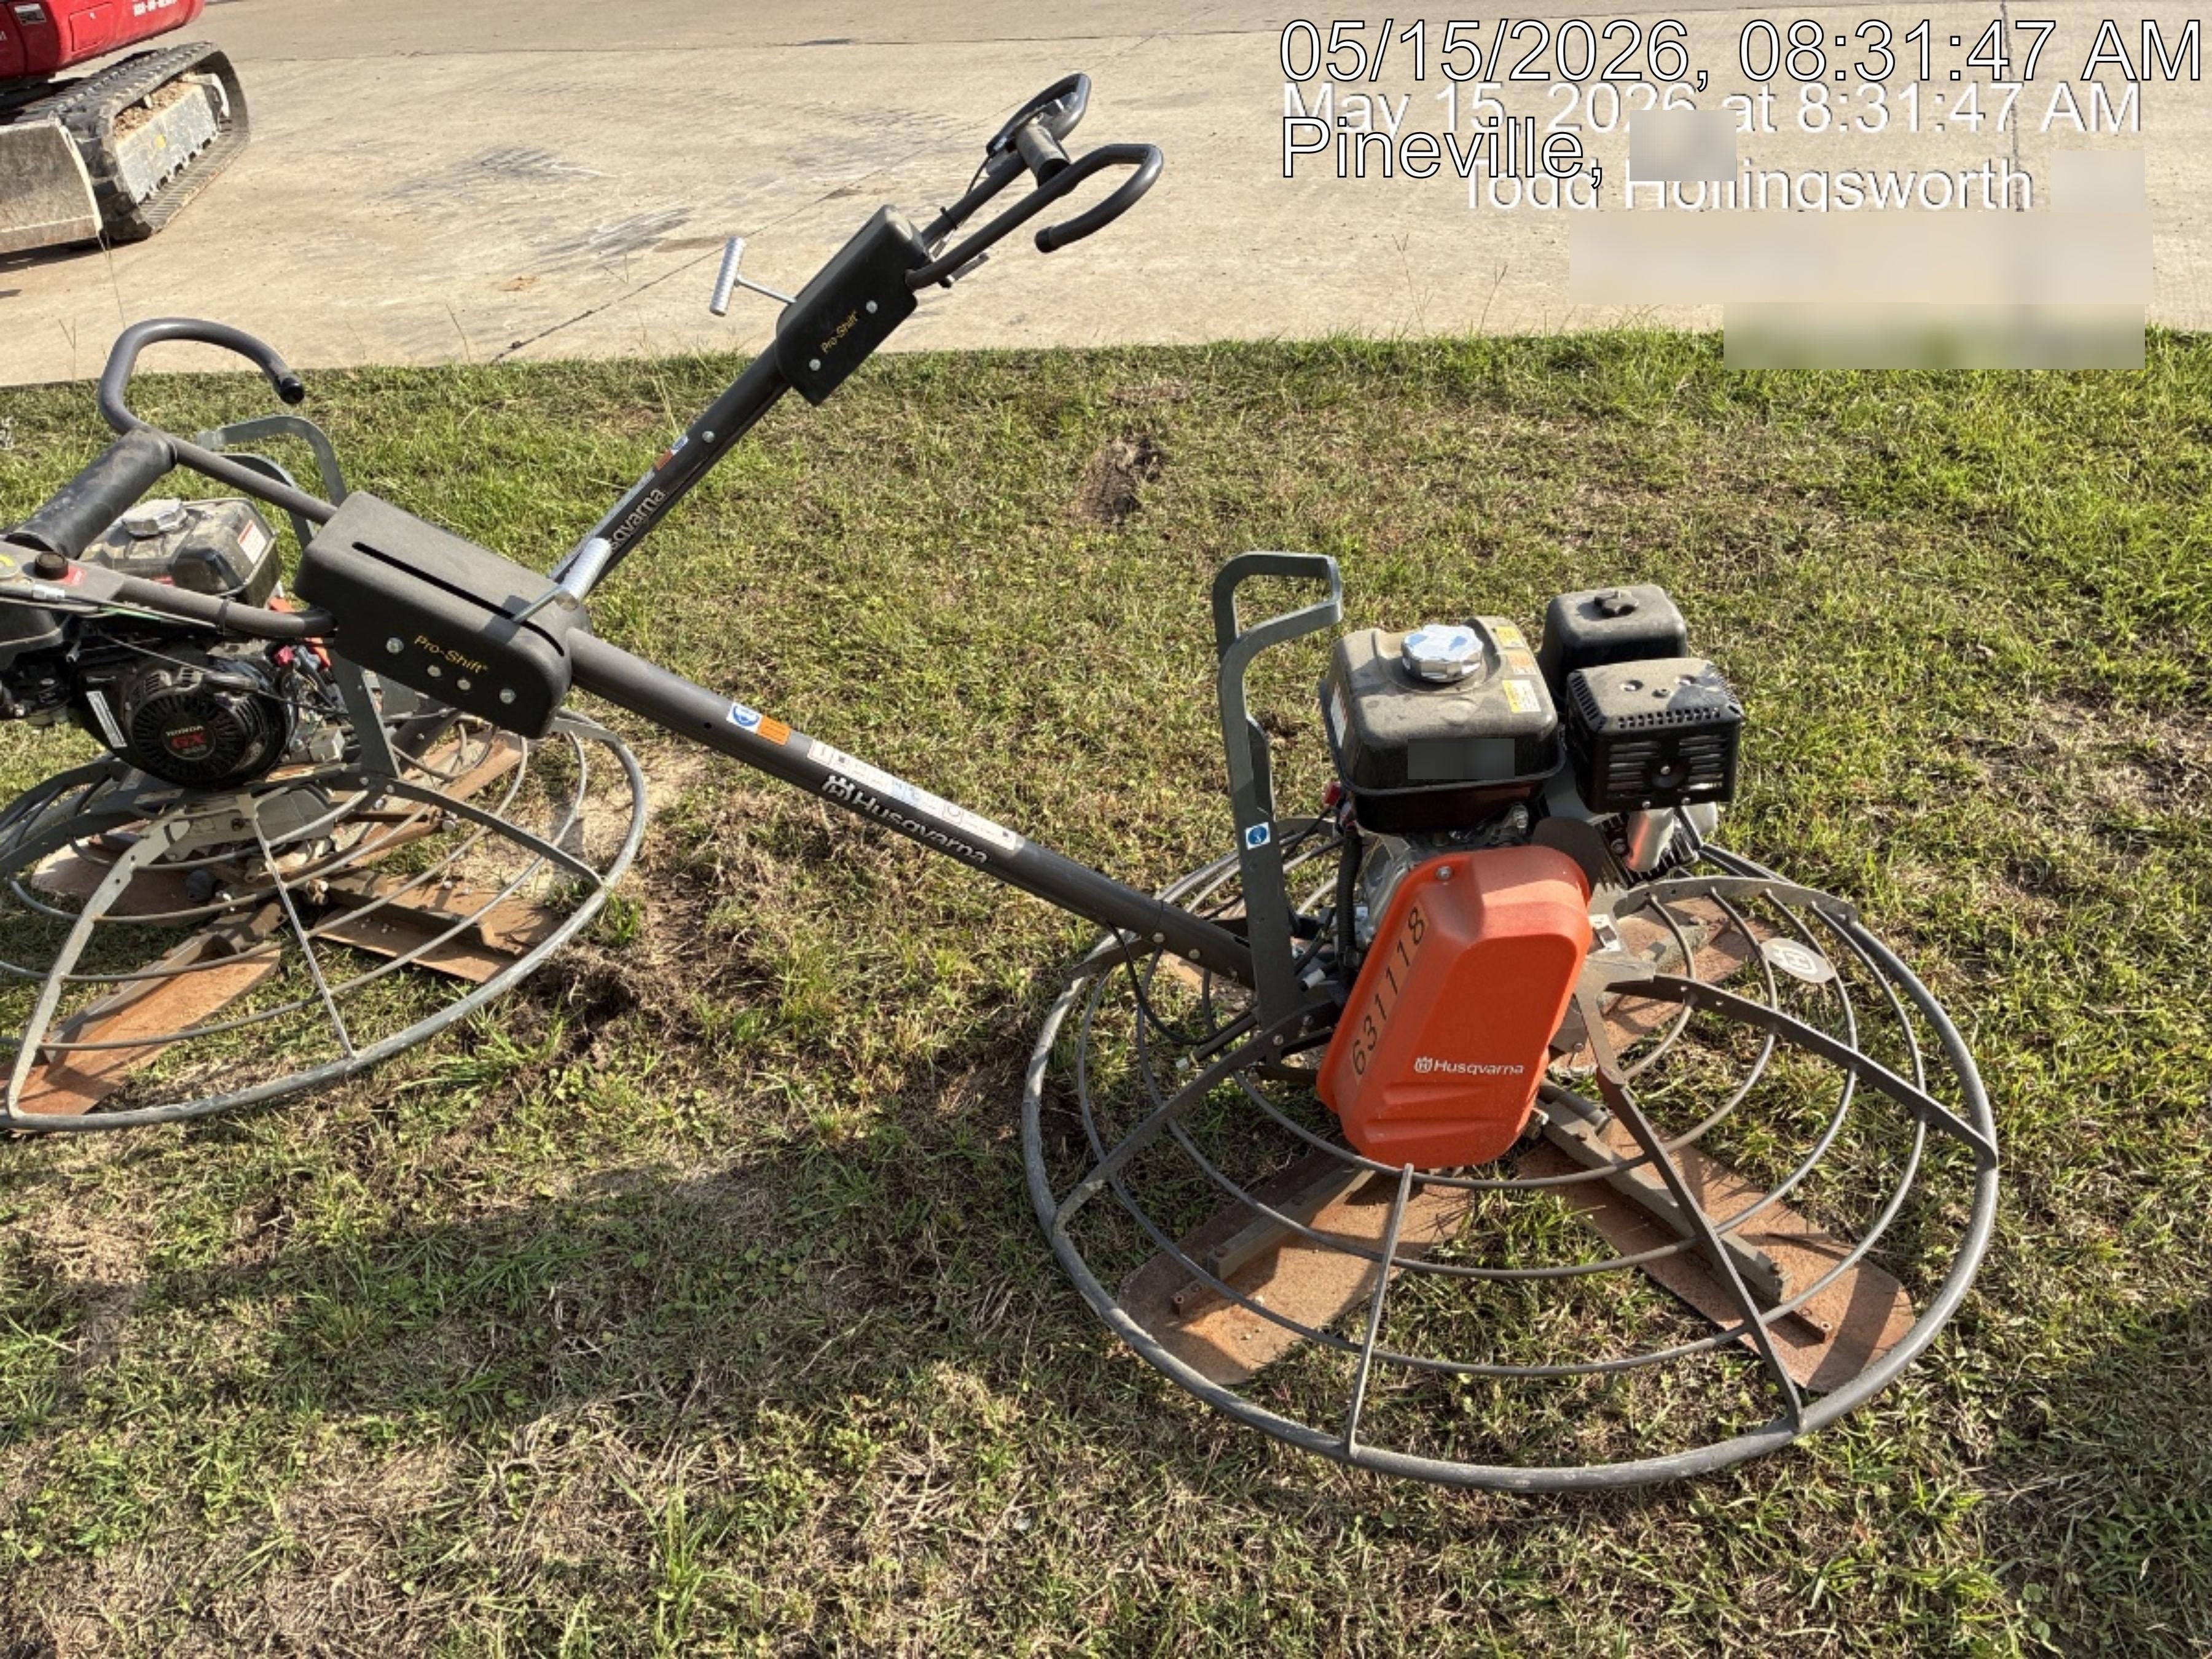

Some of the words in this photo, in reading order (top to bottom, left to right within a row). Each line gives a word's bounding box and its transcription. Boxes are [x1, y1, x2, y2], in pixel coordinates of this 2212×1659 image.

[610, 489, 666, 551] sqvarna
[851, 790, 988, 863] Husqvarna
[1352, 906, 1426, 1075] 631118
[1433, 1059, 1524, 1075] Husqvarna
